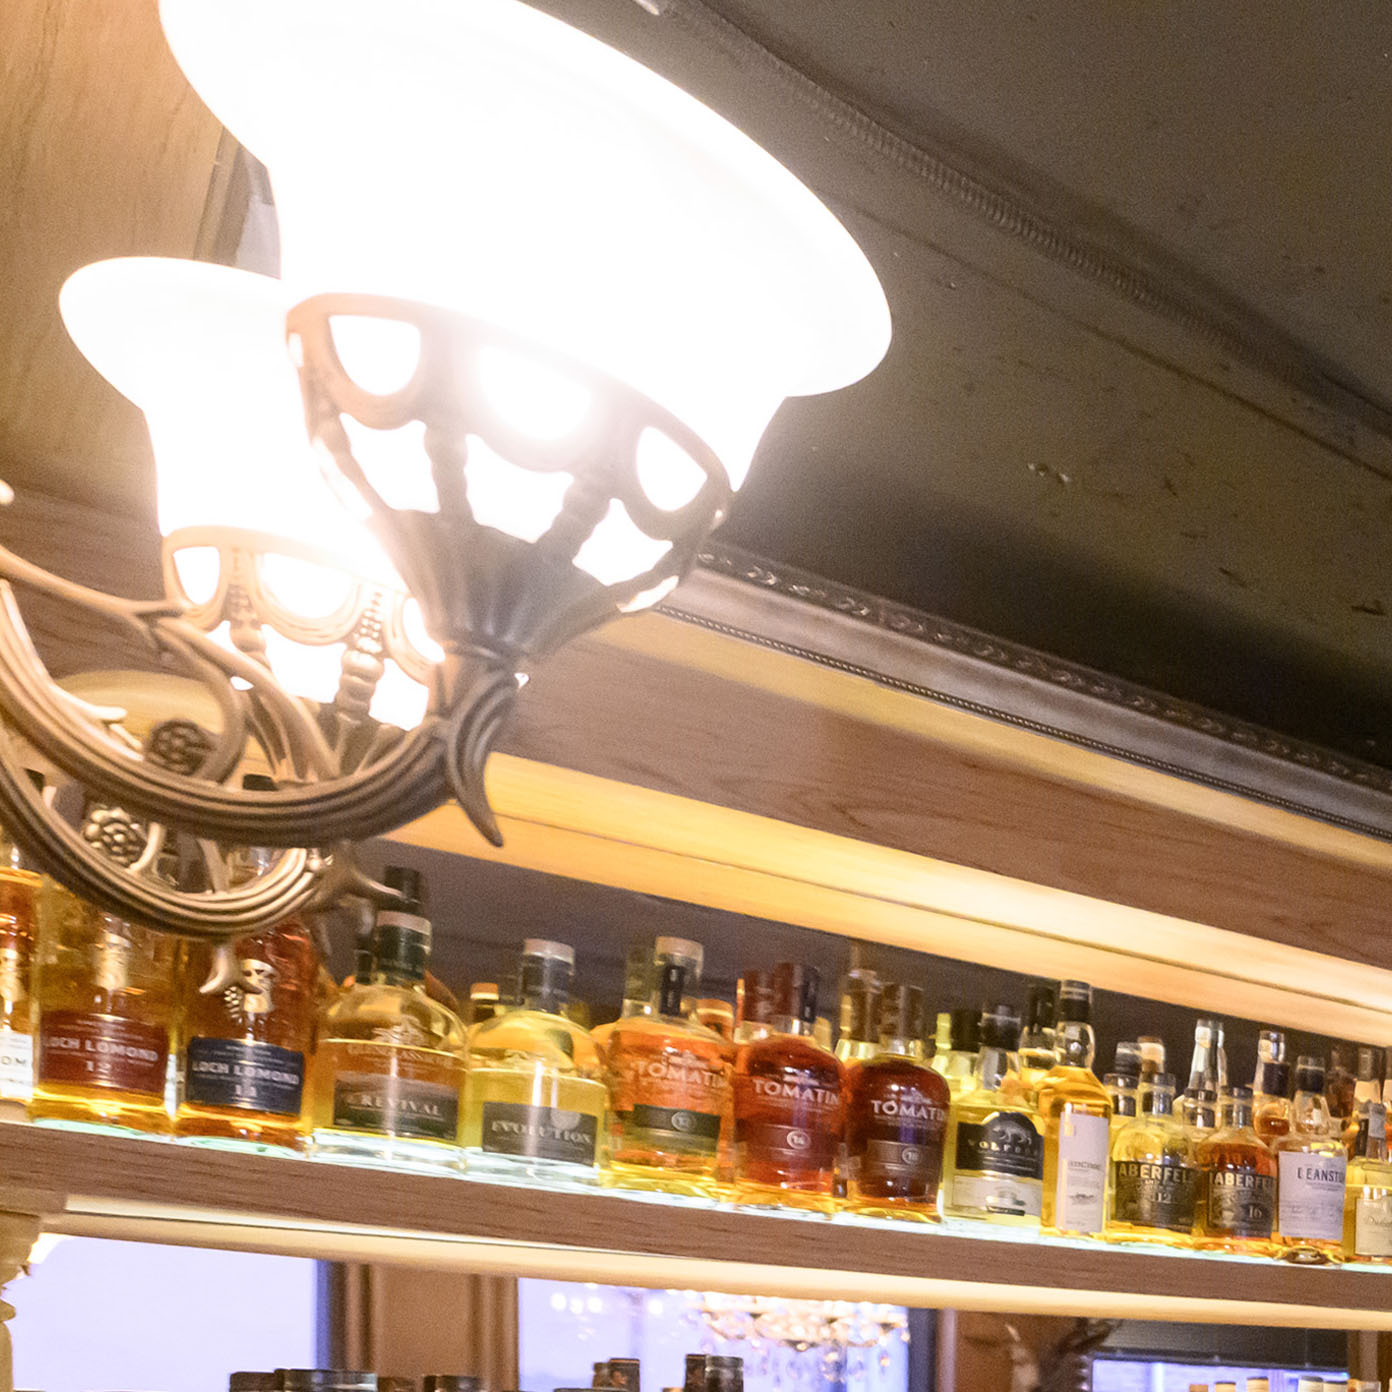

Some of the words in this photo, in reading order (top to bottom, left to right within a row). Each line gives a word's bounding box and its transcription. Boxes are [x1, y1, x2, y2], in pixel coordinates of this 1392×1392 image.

[85, 1038, 159, 1062] LOMOND
[192, 1061, 229, 1075] LOCH
[234, 1063, 300, 1085] LOMOND
[753, 1078, 841, 1104] TOMATIN
[492, 1120, 592, 1145] EVOLUTION
